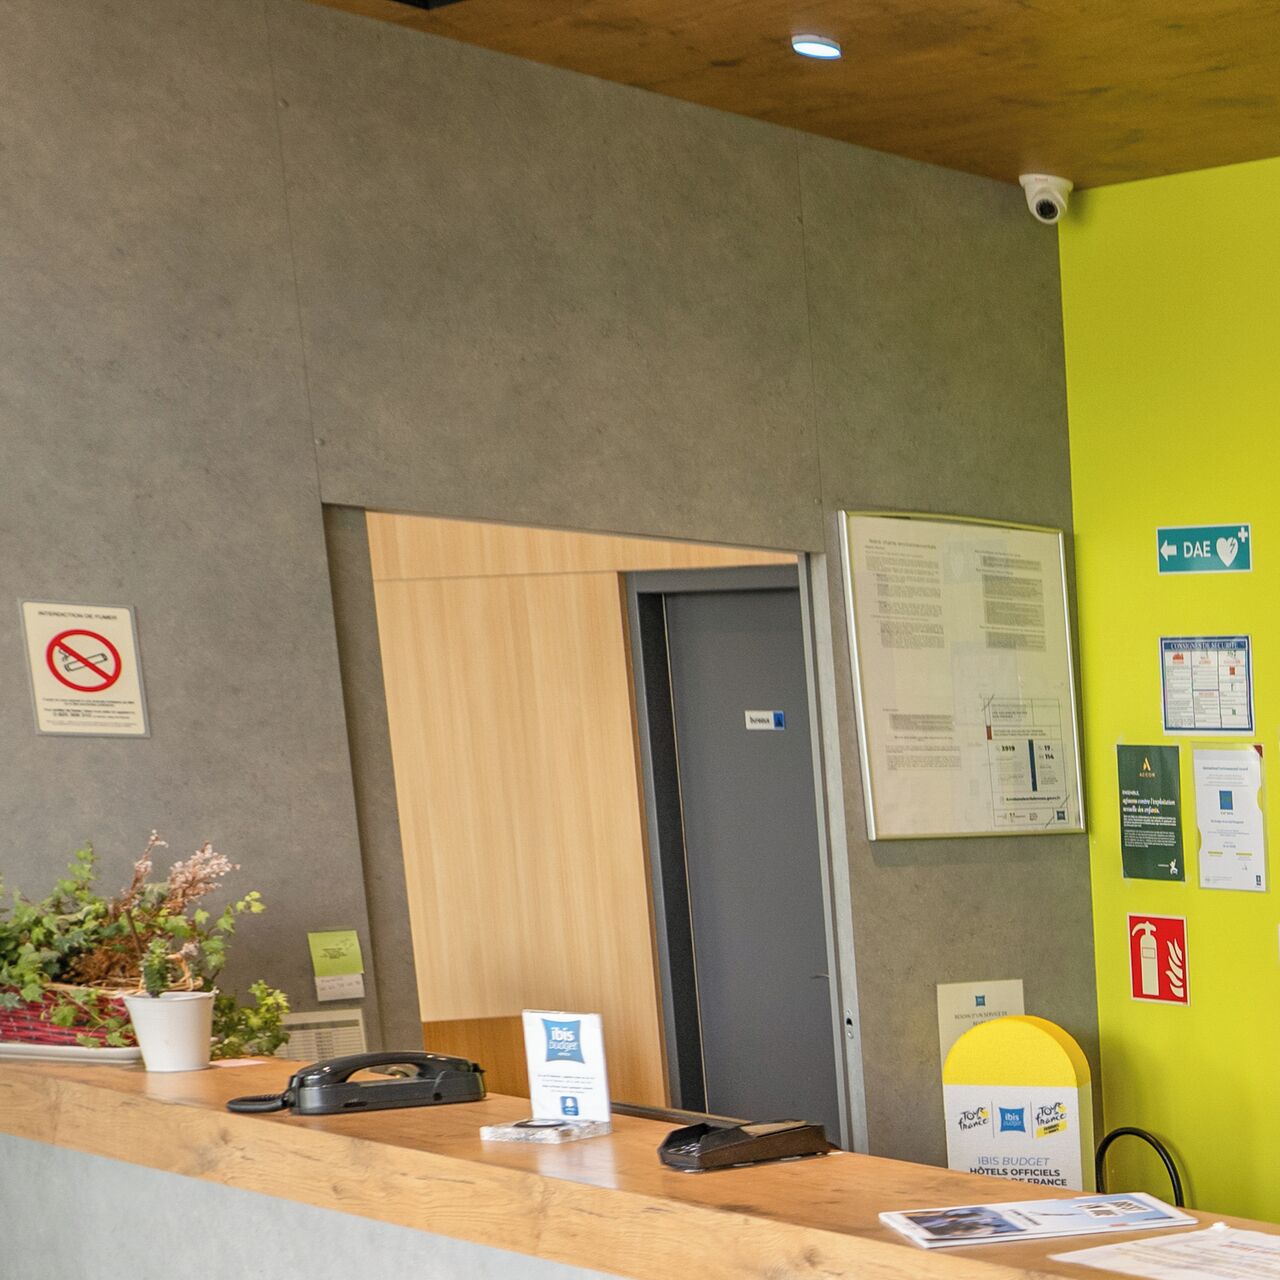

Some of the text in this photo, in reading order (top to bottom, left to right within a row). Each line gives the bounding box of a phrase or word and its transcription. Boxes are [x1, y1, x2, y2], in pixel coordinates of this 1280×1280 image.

[1183, 540, 1211, 558] DAE
[551, 1027, 575, 1041] ibis
[549, 1040, 578, 1053] budget
[1004, 1113, 1020, 1121] ibis
[977, 1156, 1050, 1167] IBIS BUDGET
[970, 1166, 1061, 1177] HÔTELS OFFICIELS
[1027, 1178, 1068, 1187] FRANCE
